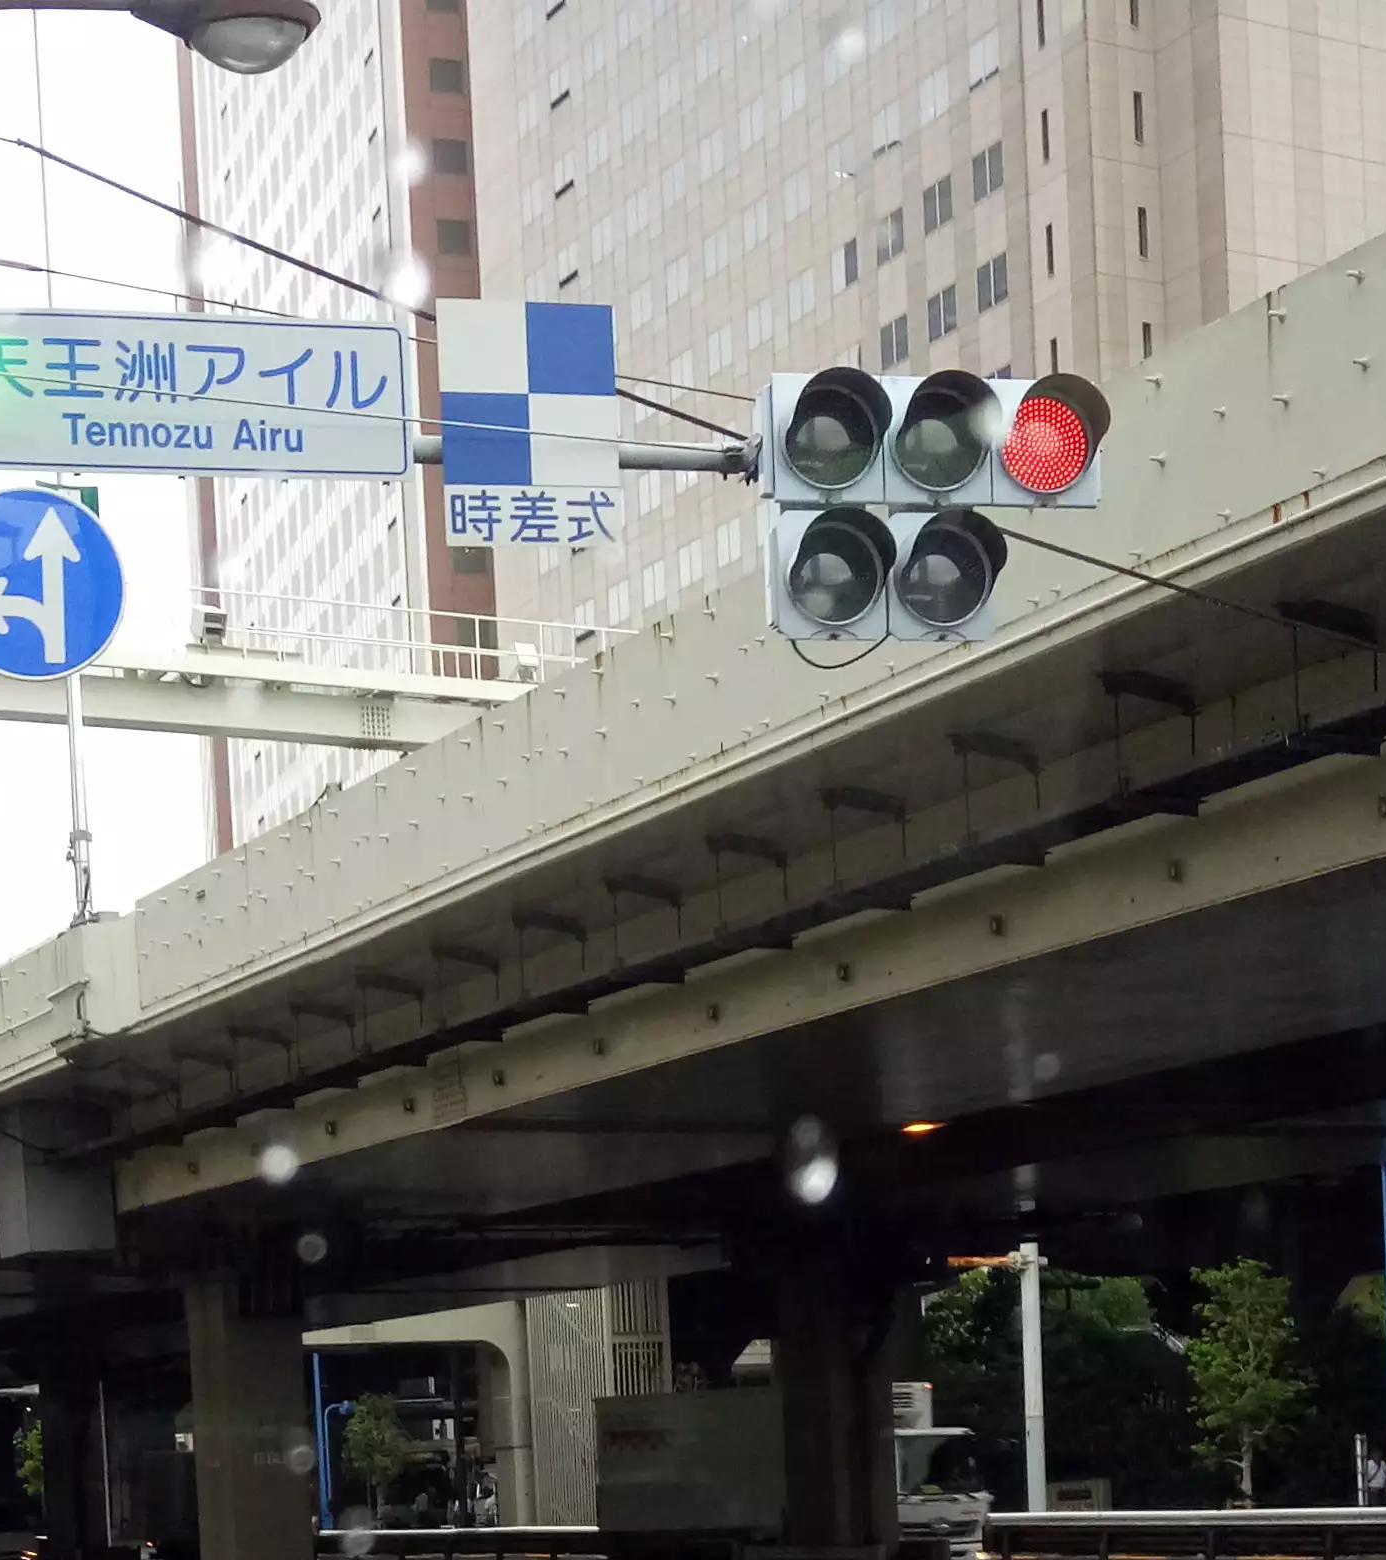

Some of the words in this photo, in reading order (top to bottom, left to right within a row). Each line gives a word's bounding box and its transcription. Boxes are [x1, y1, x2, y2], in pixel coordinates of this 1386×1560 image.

[62, 412, 214, 450] Tennozu
[232, 417, 304, 452] Airu
[450, 489, 616, 543] 時差式
